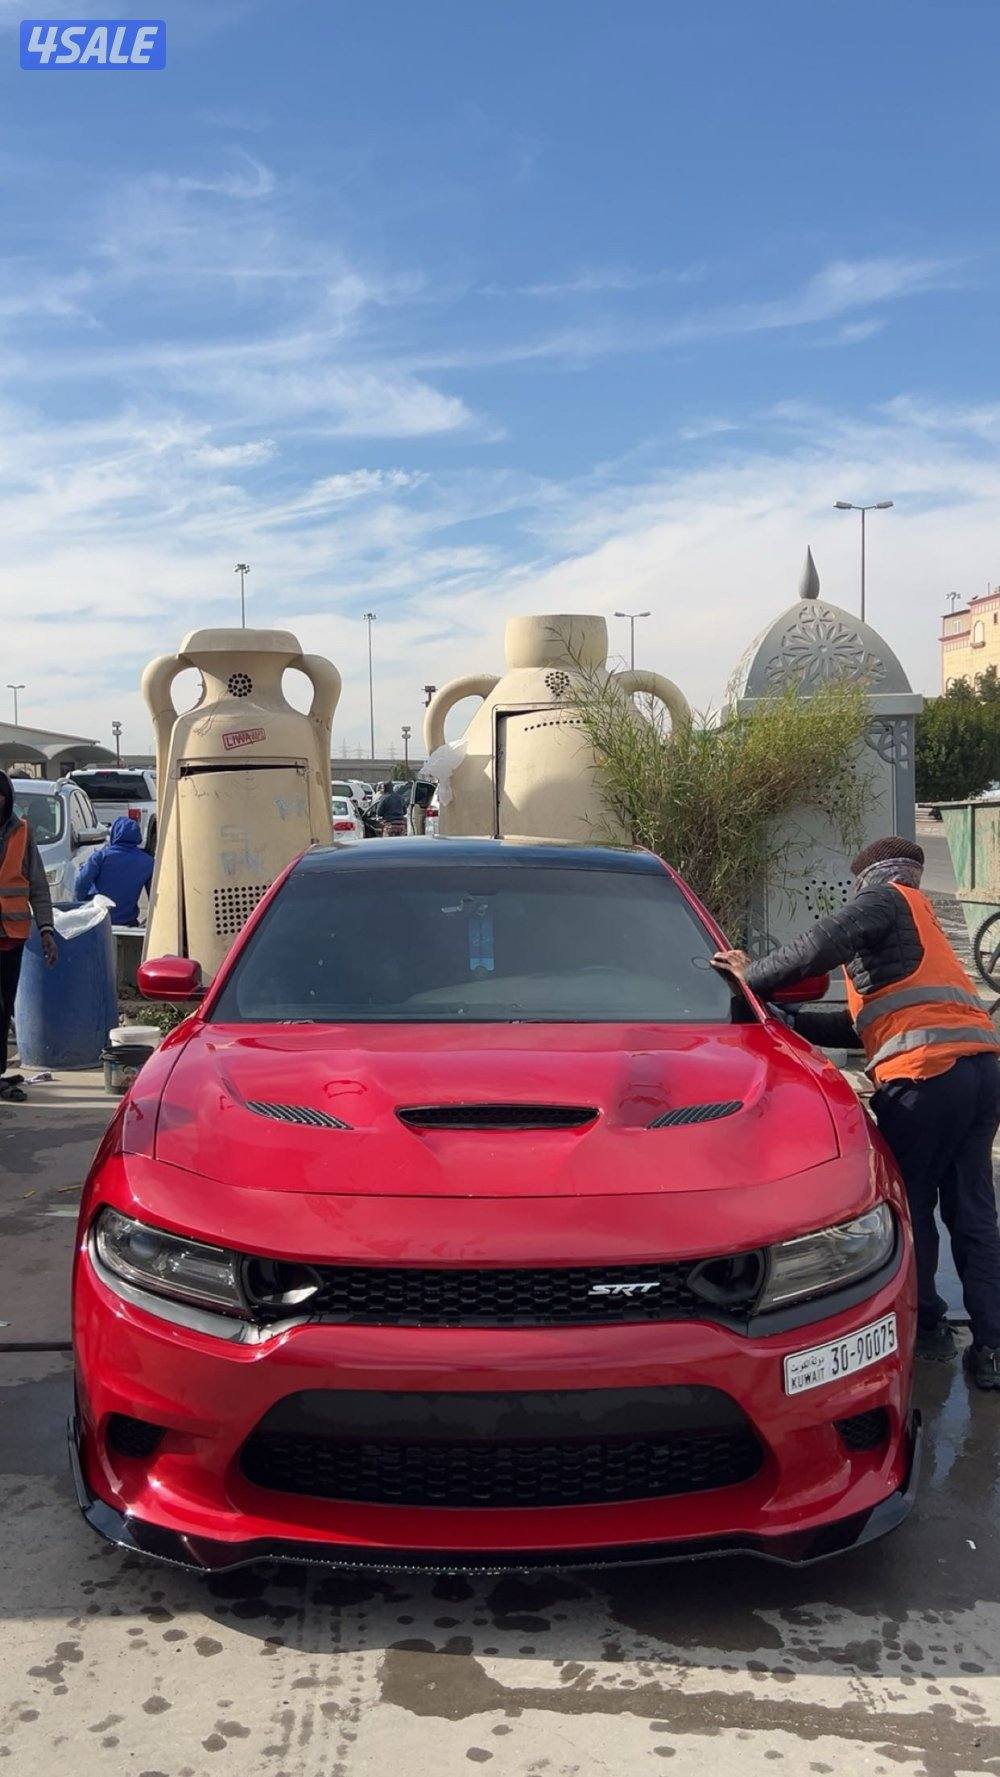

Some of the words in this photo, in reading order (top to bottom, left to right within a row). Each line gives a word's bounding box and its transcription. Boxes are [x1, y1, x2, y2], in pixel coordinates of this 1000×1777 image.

[588, 1282, 660, 1297] SRT
[830, 1320, 895, 1375] 30-90075
[791, 1367, 825, 1390] KUWAIT
